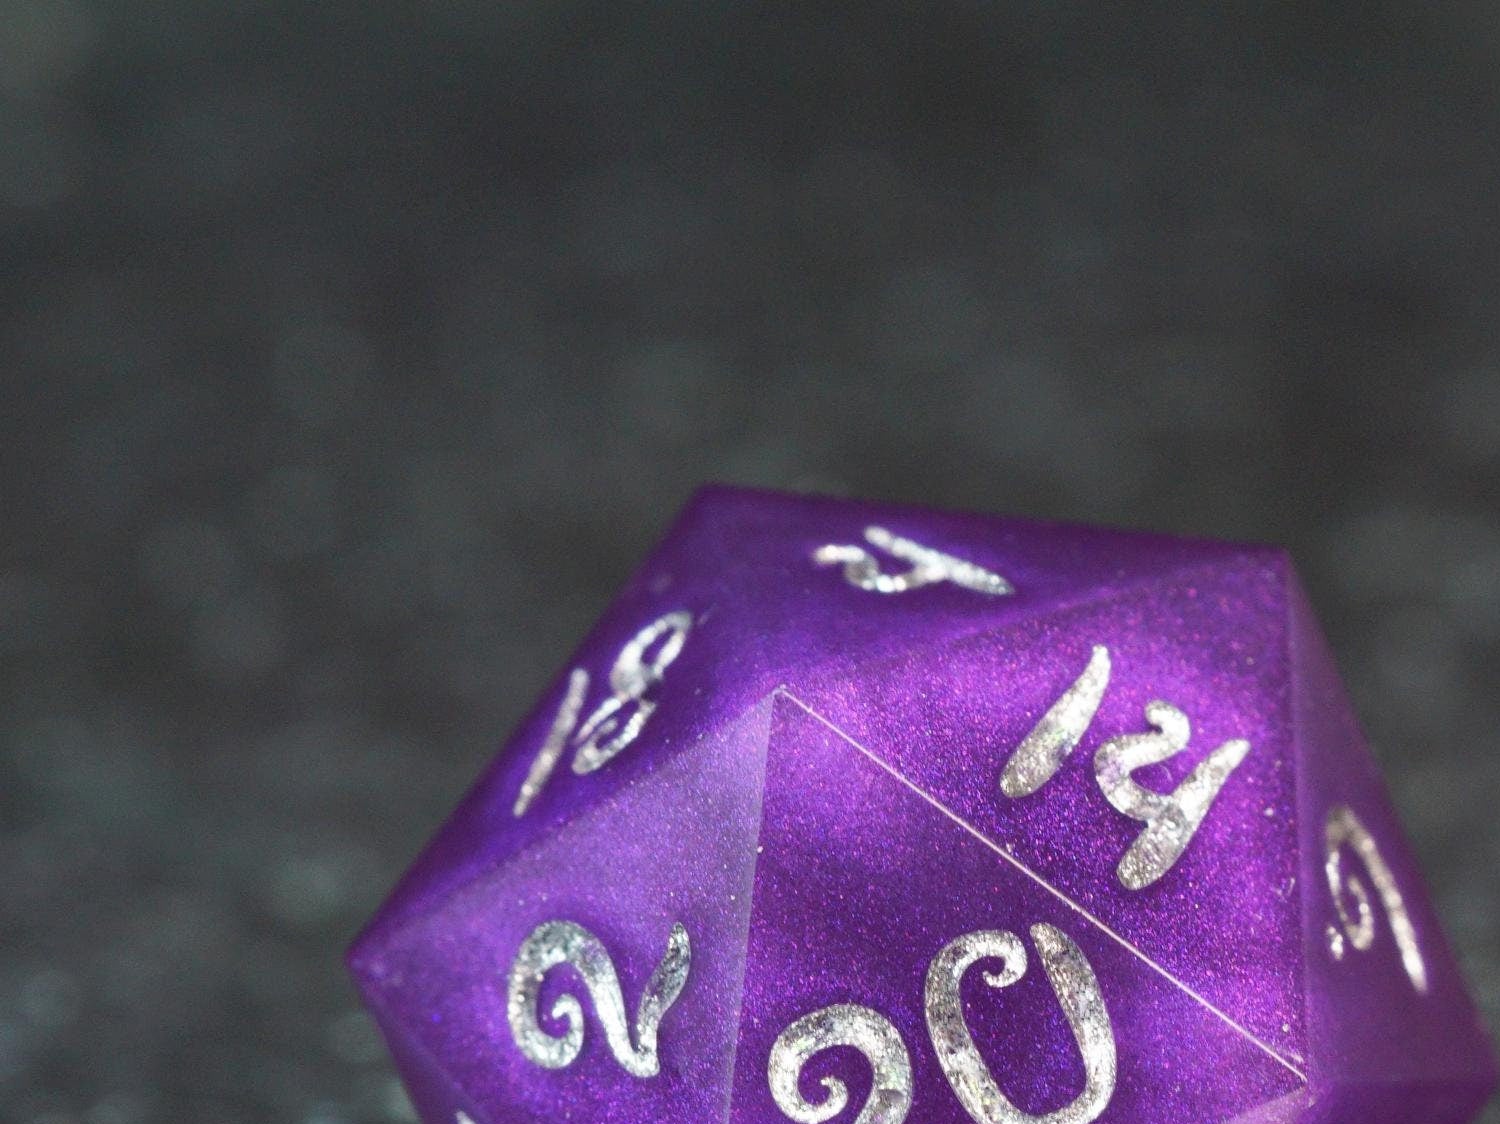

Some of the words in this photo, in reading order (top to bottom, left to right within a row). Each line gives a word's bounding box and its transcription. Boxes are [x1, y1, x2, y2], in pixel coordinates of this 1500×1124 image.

[514, 611, 694, 817] 18
[1000, 643, 1250, 890] 14
[507, 920, 692, 1077] 2
